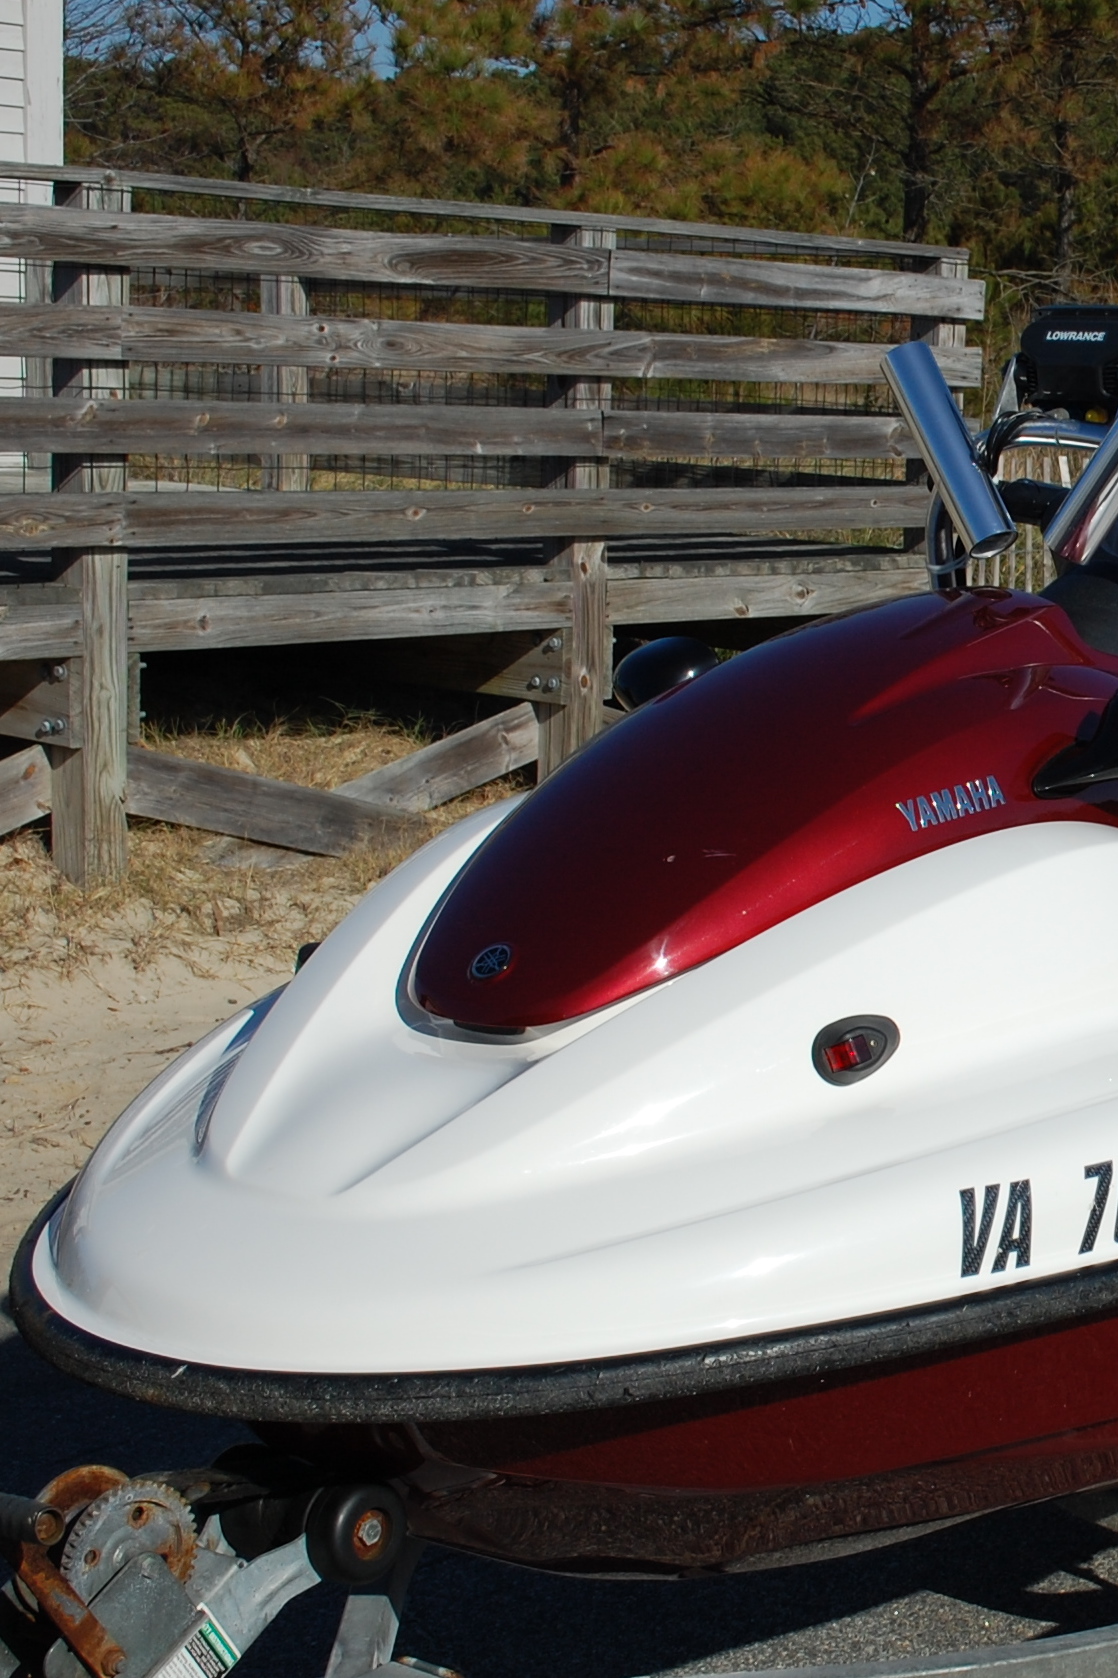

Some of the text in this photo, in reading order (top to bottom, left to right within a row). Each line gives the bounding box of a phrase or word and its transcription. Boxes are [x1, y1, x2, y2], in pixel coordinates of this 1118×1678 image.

[1046, 331, 1106, 342] LOWRANCE
[895, 775, 1006, 831] YAMAHA
[959, 1178, 1032, 1278] VA
